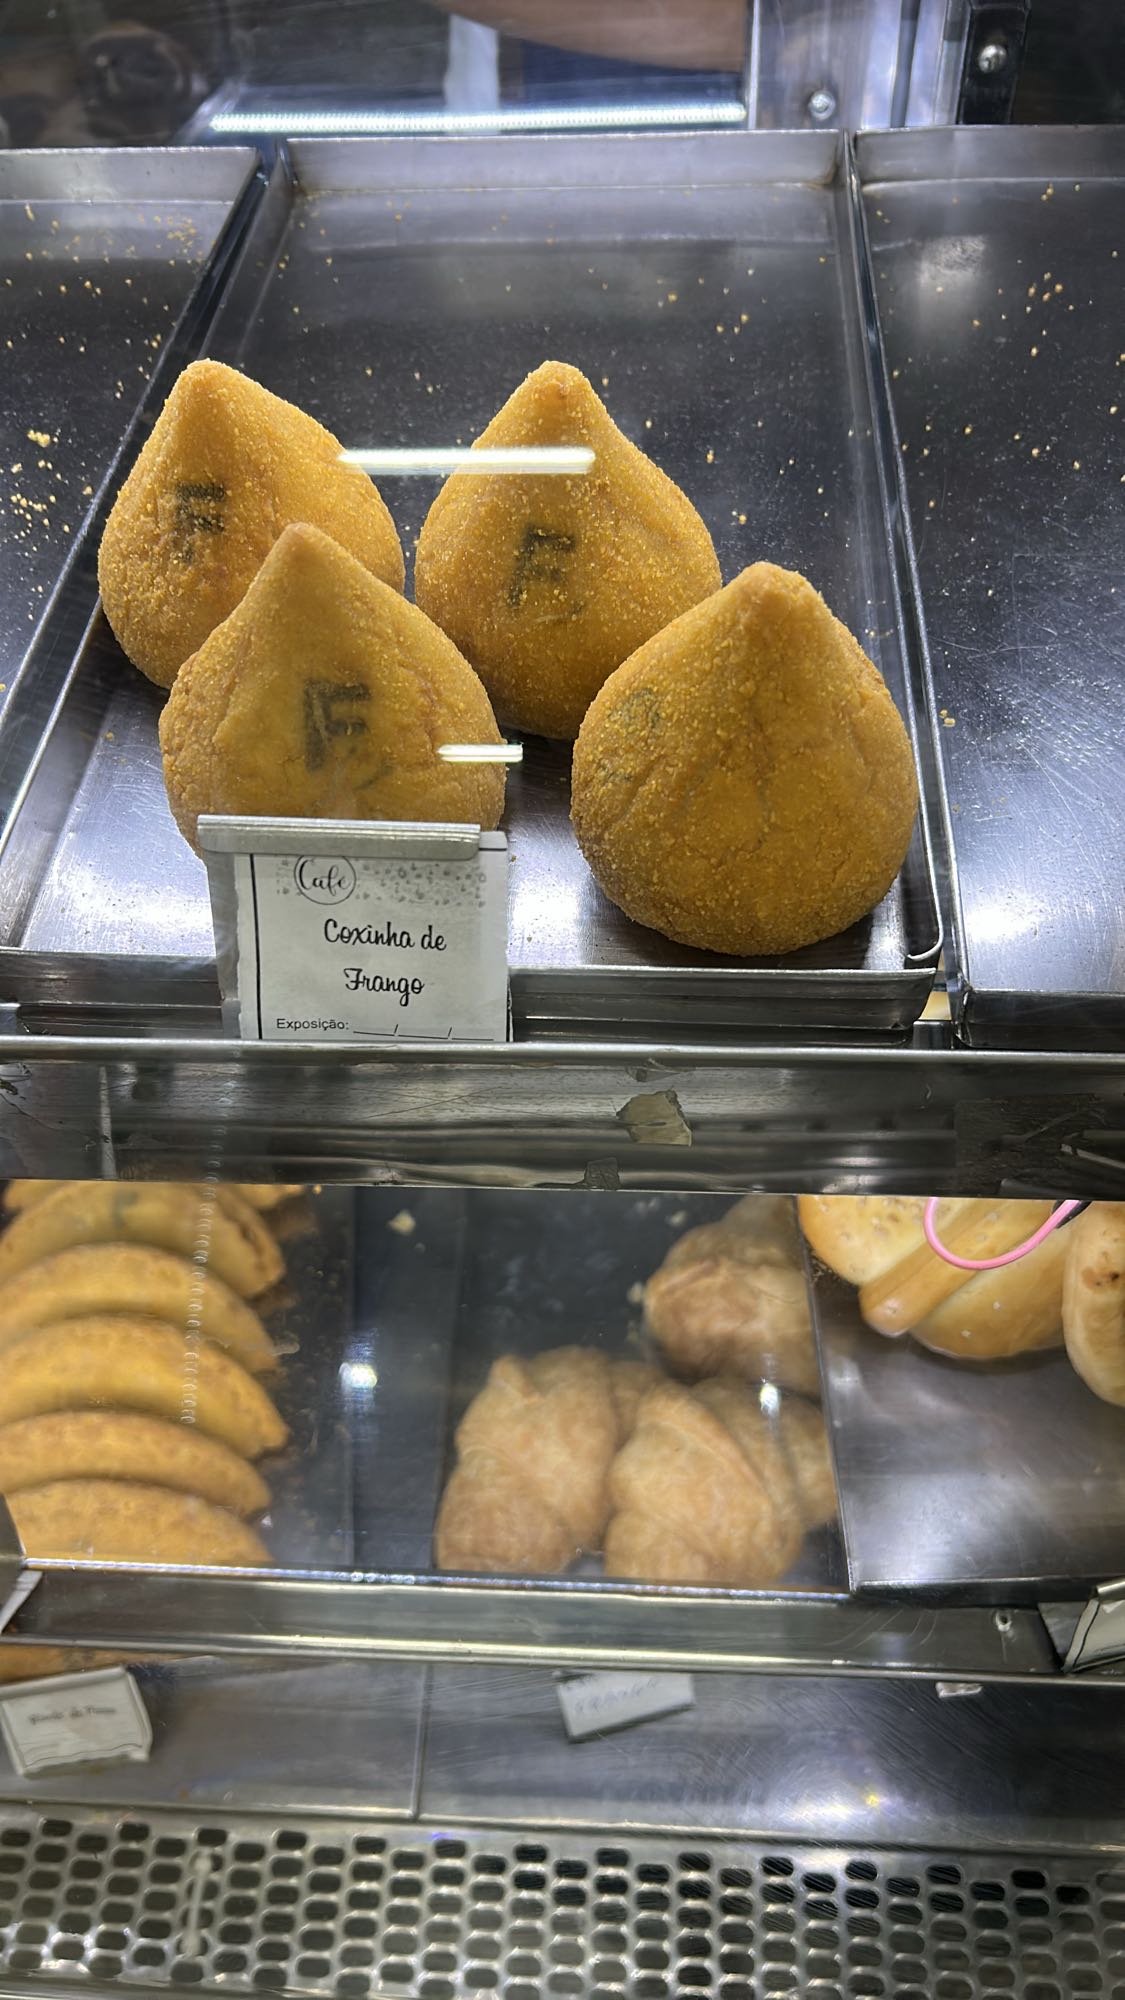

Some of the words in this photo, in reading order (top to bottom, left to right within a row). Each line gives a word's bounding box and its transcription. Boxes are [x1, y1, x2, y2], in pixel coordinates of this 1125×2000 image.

[324, 919, 414, 949] Coxinha
[421, 925, 447, 951] de
[344, 968, 424, 1006] Frango
[276, 1019, 349, 1030] Exposição:
